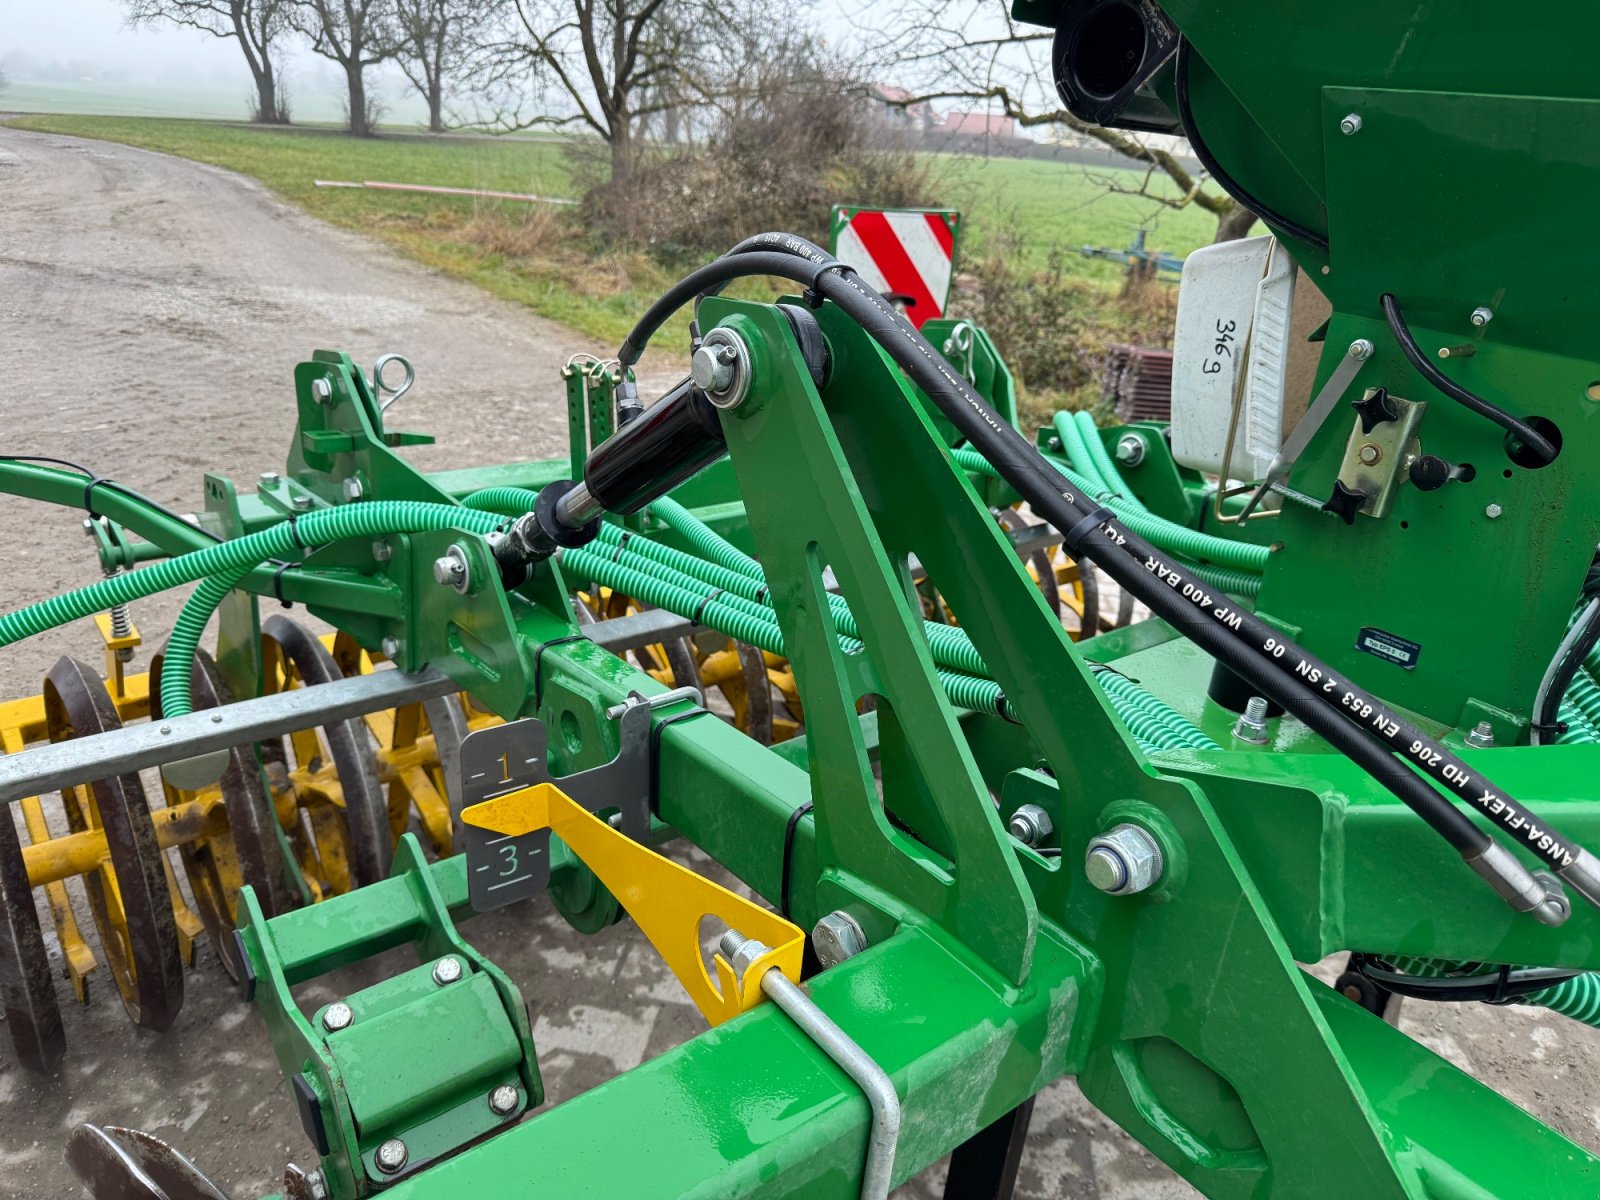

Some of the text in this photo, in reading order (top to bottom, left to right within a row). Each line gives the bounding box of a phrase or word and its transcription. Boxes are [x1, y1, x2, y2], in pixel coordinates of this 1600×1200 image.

[785, 237, 801, 251] BAR
[811, 254, 825, 265] WP
[1214, 318, 1236, 358] 346
[1098, 521, 1575, 866] ANSA-FLEX HD 206 EN 853 2 SN 06 WP 400 BAR 4Q1
[496, 752, 513, 784] 1
[499, 845, 518, 876] 3
